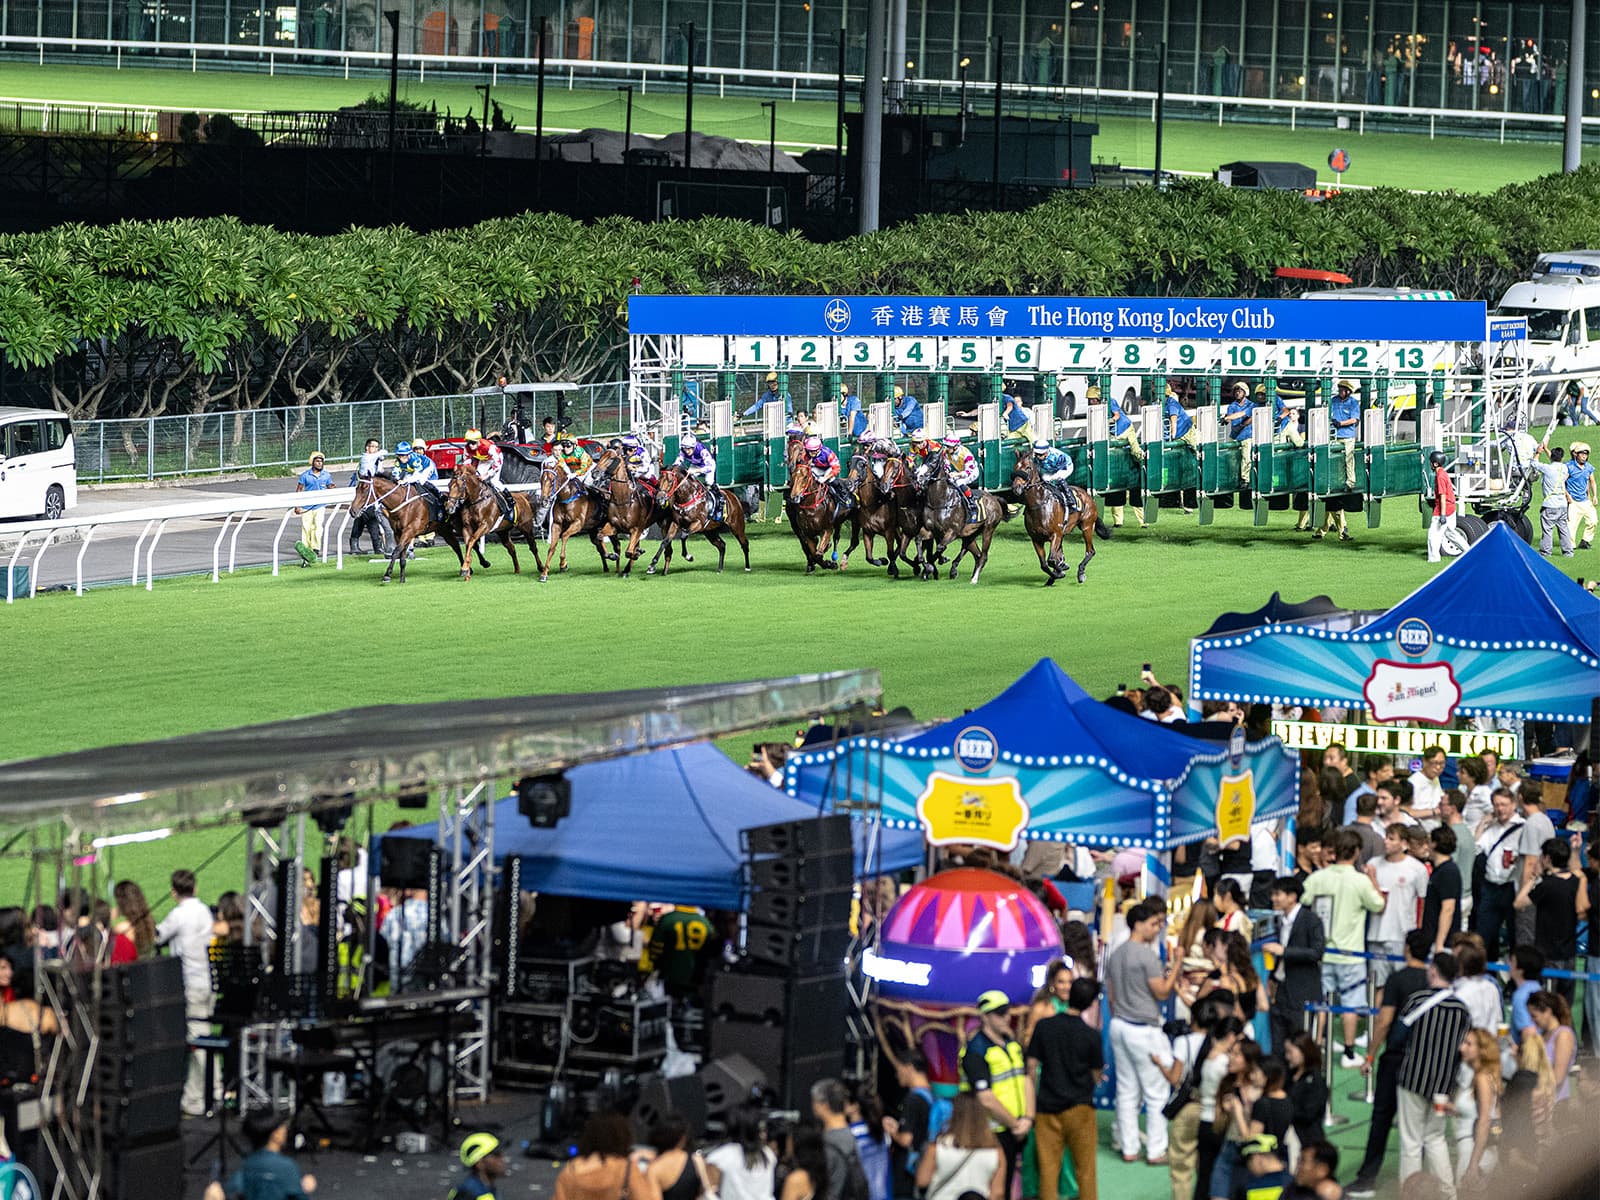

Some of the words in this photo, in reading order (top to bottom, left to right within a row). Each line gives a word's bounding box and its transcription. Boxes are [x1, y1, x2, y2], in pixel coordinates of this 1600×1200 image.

[1331, 150, 1345, 171] 4
[872, 305, 1008, 327] 香港賽馬會
[1028, 305, 1062, 326] The
[1067, 306, 1114, 333] Hong
[1118, 307, 1164, 334] Kong
[1165, 307, 1229, 334] Jockey
[1232, 307, 1275, 329] Club
[751, 342, 761, 362] 1
[802, 342, 816, 362] 2
[854, 342, 869, 363] 3
[907, 342, 923, 363] 4
[961, 343, 977, 363] 5
[1015, 343, 1031, 364] 6
[1069, 343, 1086, 364] 7
[1124, 344, 1140, 364] 8
[1179, 345, 1195, 365] 9
[1228, 346, 1256, 366] 10
[1285, 346, 1312, 367] 11
[1338, 347, 1368, 367] 12
[1395, 348, 1423, 368] 13
[1400, 629, 1429, 645] BEER
[1387, 692, 1405, 703] San
[959, 738, 993, 759] BEER
[674, 920, 707, 950] 19
